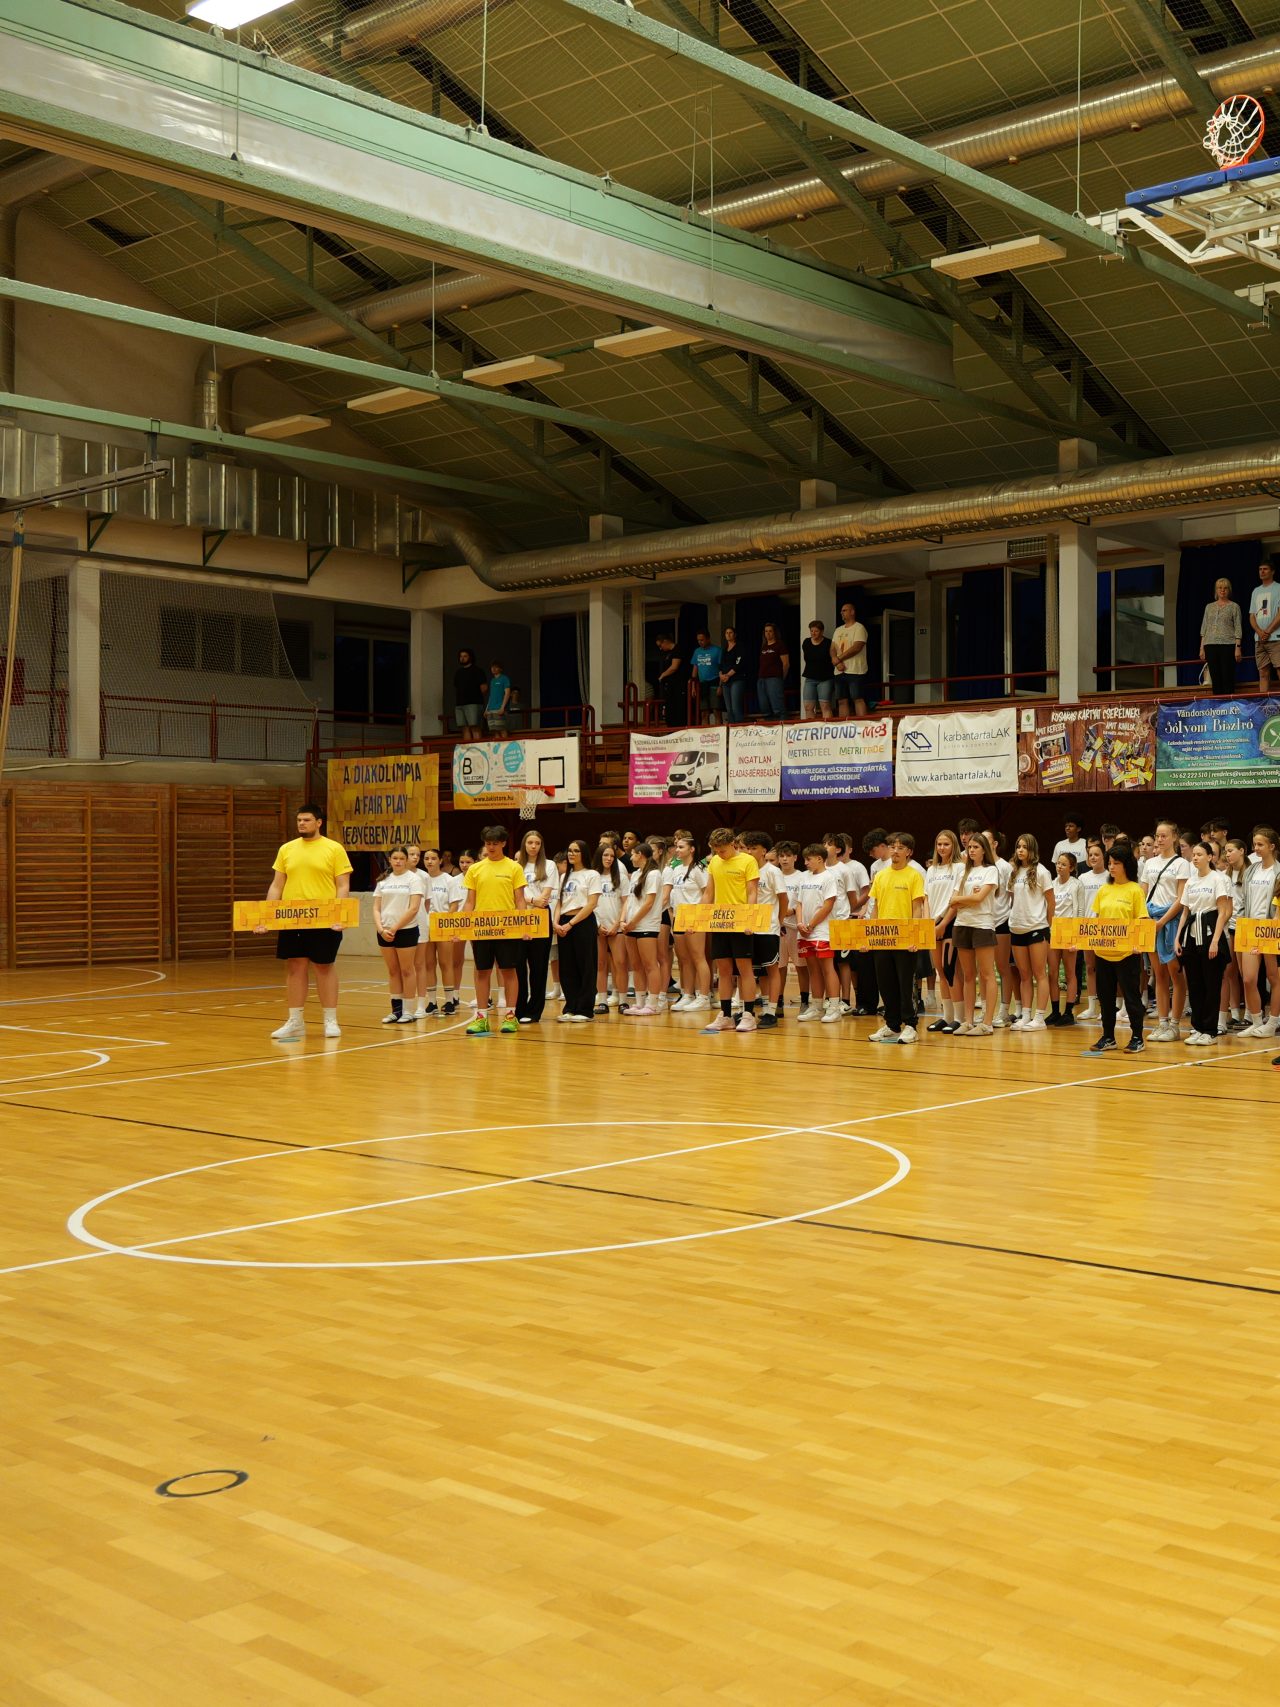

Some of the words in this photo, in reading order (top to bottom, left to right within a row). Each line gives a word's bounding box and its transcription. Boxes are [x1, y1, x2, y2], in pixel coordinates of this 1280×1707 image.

[1177, 706, 1228, 718] Vándorsólyom
[943, 727, 1011, 742] karbantartaLAK
[1164, 720, 1207, 737] Sólyom
[1212, 718, 1254, 733] Bisztró
[462, 757, 472, 775] B
[738, 755, 772, 765] INGATLAN
[343, 765, 350, 785] A
[907, 769, 1002, 783] www.karbantartalak.hu
[354, 796, 361, 815] A
[363, 795, 382, 815] FAIR
[386, 794, 408, 814] PLAY
[390, 824, 421, 845] ZAJLIK
[275, 907, 319, 919] BUDAPEST
[713, 908, 736, 920] BÉKÉS
[438, 913, 540, 929] BORSOD-ABAÚJ-ZEMPLÉN
[474, 928, 506, 937] VÁRMEGYE
[865, 925, 899, 937] BARANYA
[1079, 923, 1128, 937] BÁCS-KISKUN
[868, 937, 897, 947] VÁRMEGYE
[1088, 938, 1116, 947] VÁRMEGYE
